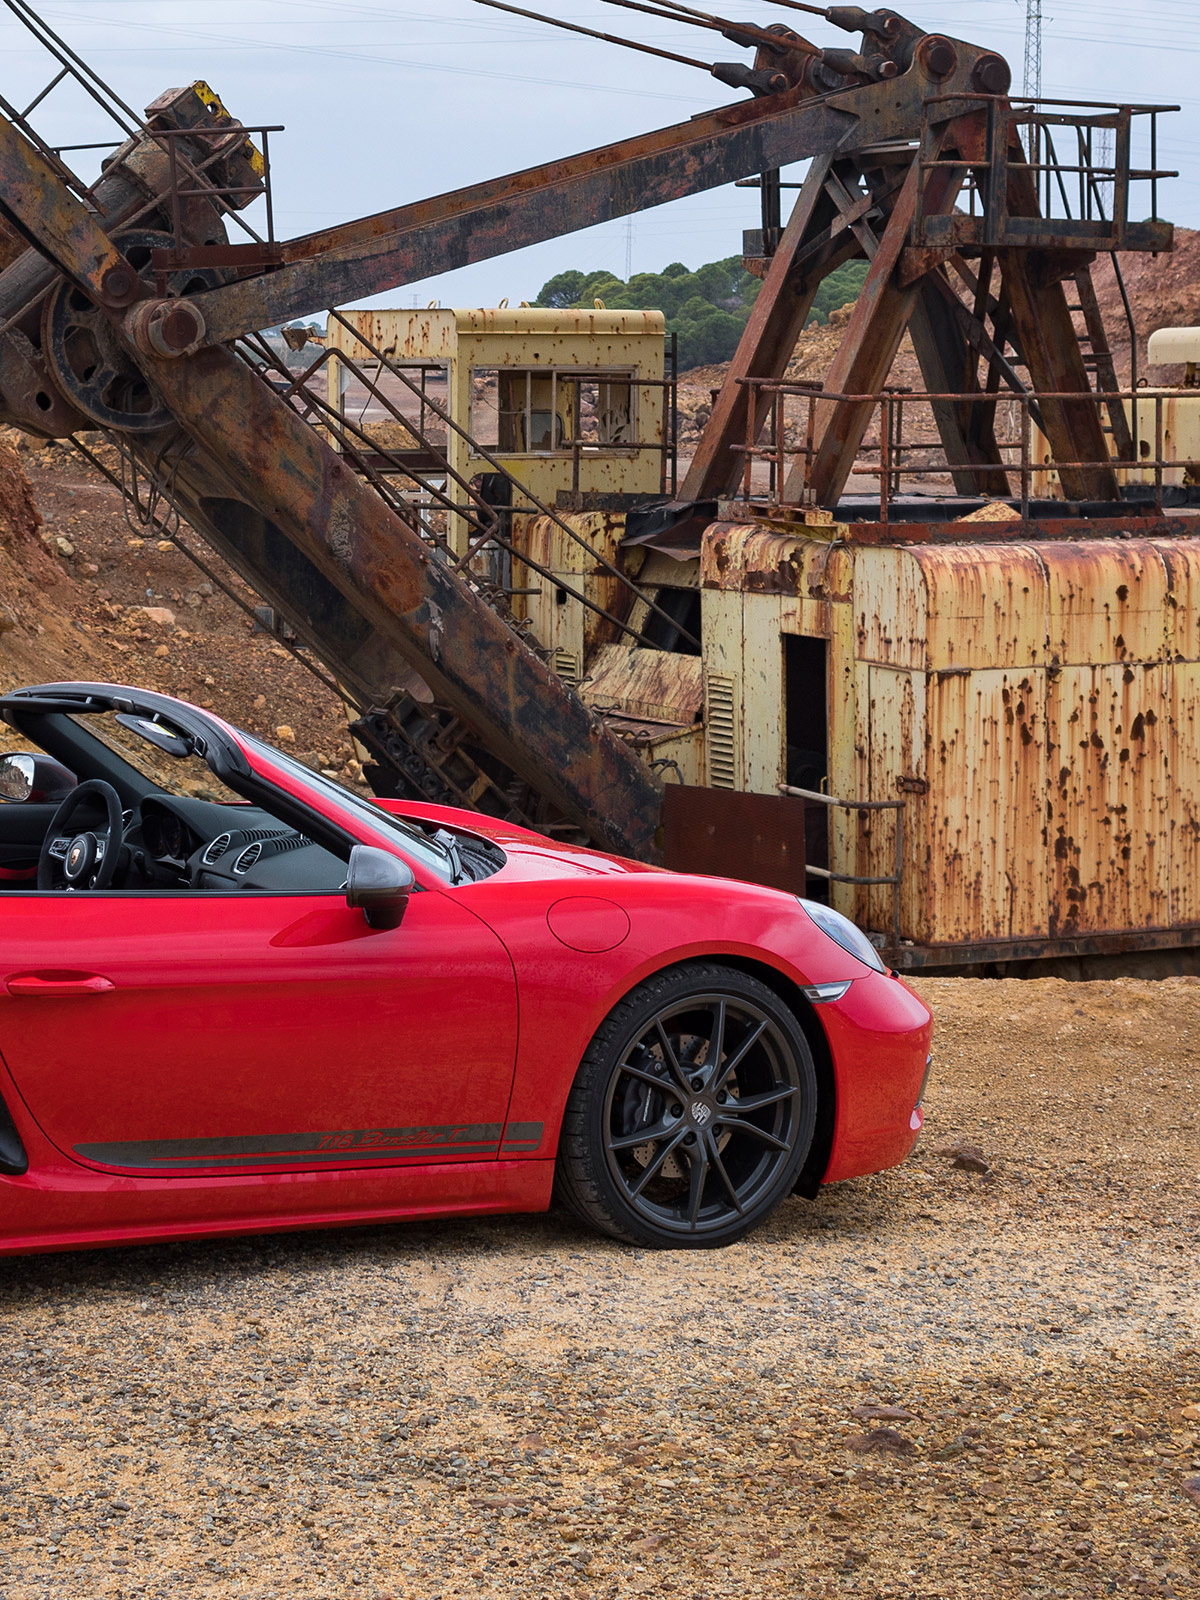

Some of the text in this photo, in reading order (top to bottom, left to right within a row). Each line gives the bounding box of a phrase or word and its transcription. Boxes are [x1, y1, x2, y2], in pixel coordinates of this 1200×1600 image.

[318, 1128, 468, 1149] 718 Boxster T
